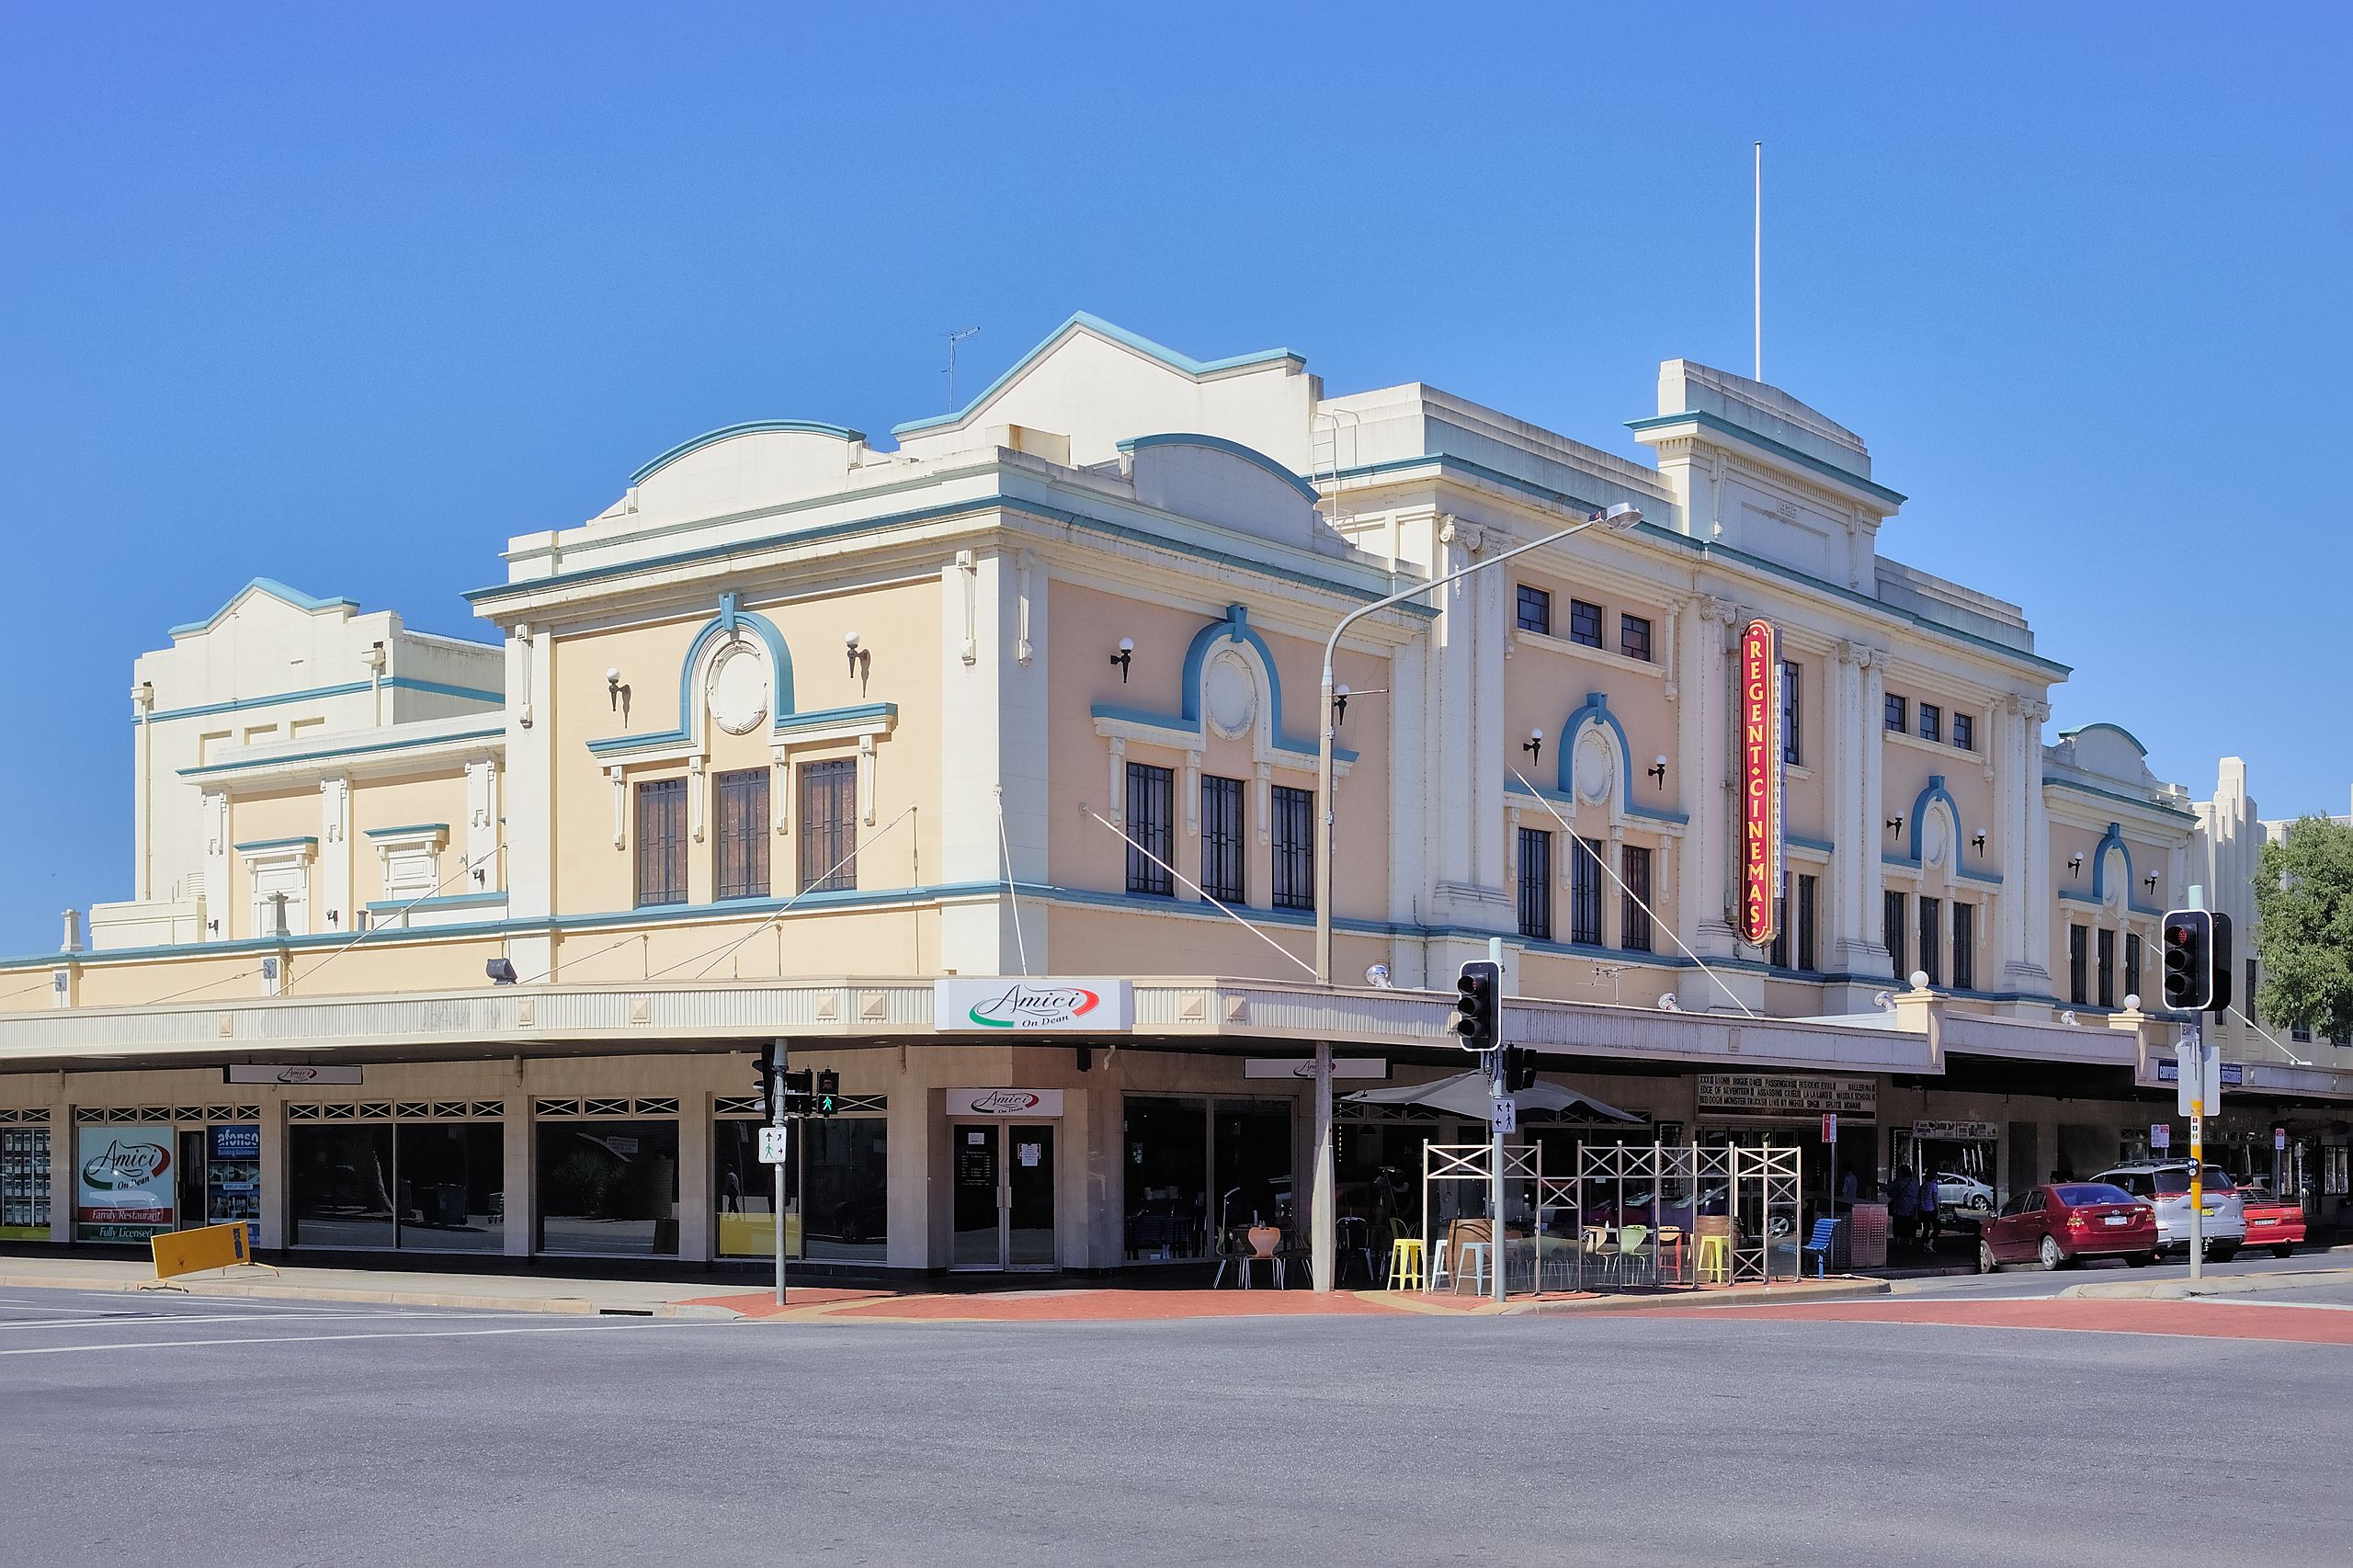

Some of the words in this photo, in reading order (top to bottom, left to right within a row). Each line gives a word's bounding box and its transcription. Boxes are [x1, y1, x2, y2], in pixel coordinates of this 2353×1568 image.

[1748, 641, 1764, 764] REGENT
[1747, 778, 1765, 923] CINEMAS
[977, 983, 1082, 1015] Amici
[1022, 1019, 1038, 1028] On
[1042, 1016, 1068, 1026] Dean
[1700, 1085, 1712, 1094] EDGE
[974, 1090, 1029, 1107] Amici
[218, 1130, 258, 1146] afonso
[87, 1140, 157, 1176] Amici
[118, 1181, 129, 1190] On
[92, 1209, 117, 1222] Family
[119, 1210, 161, 1221] Restaurant
[99, 1227, 118, 1240] Fully
[119, 1227, 153, 1238] Licensed
